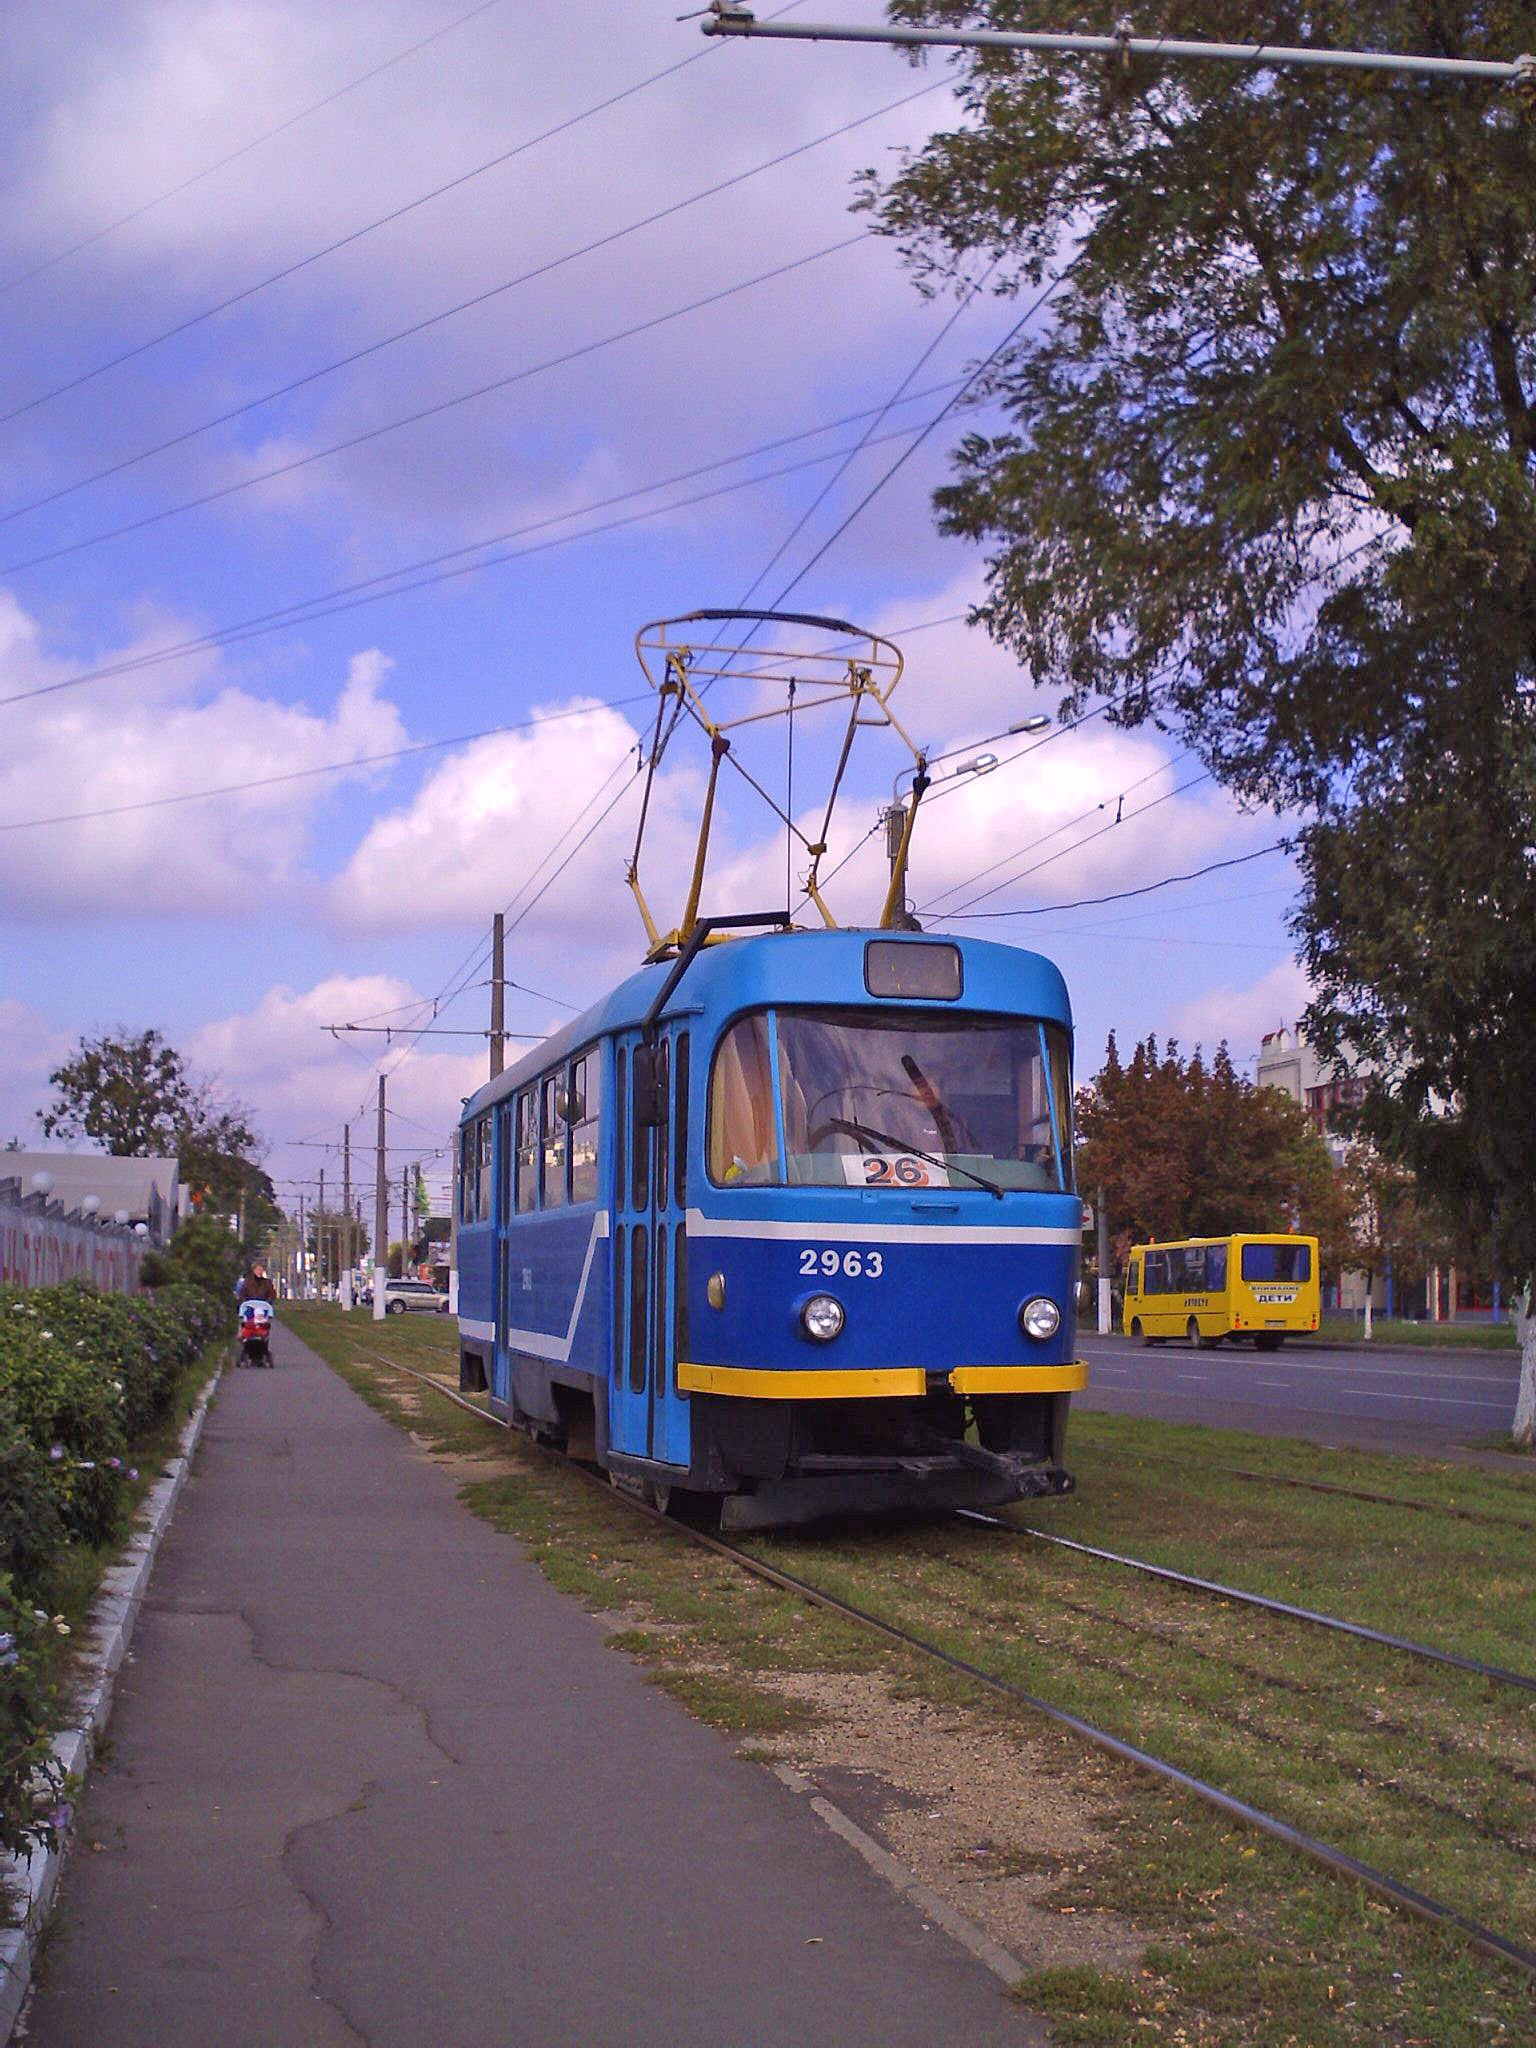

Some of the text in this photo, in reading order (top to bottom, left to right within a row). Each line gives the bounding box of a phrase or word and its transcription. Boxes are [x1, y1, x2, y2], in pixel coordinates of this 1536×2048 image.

[863, 1156, 928, 1184] 26
[799, 1249, 883, 1278] 2963
[1258, 1295, 1294, 1303] ДЕТИ
